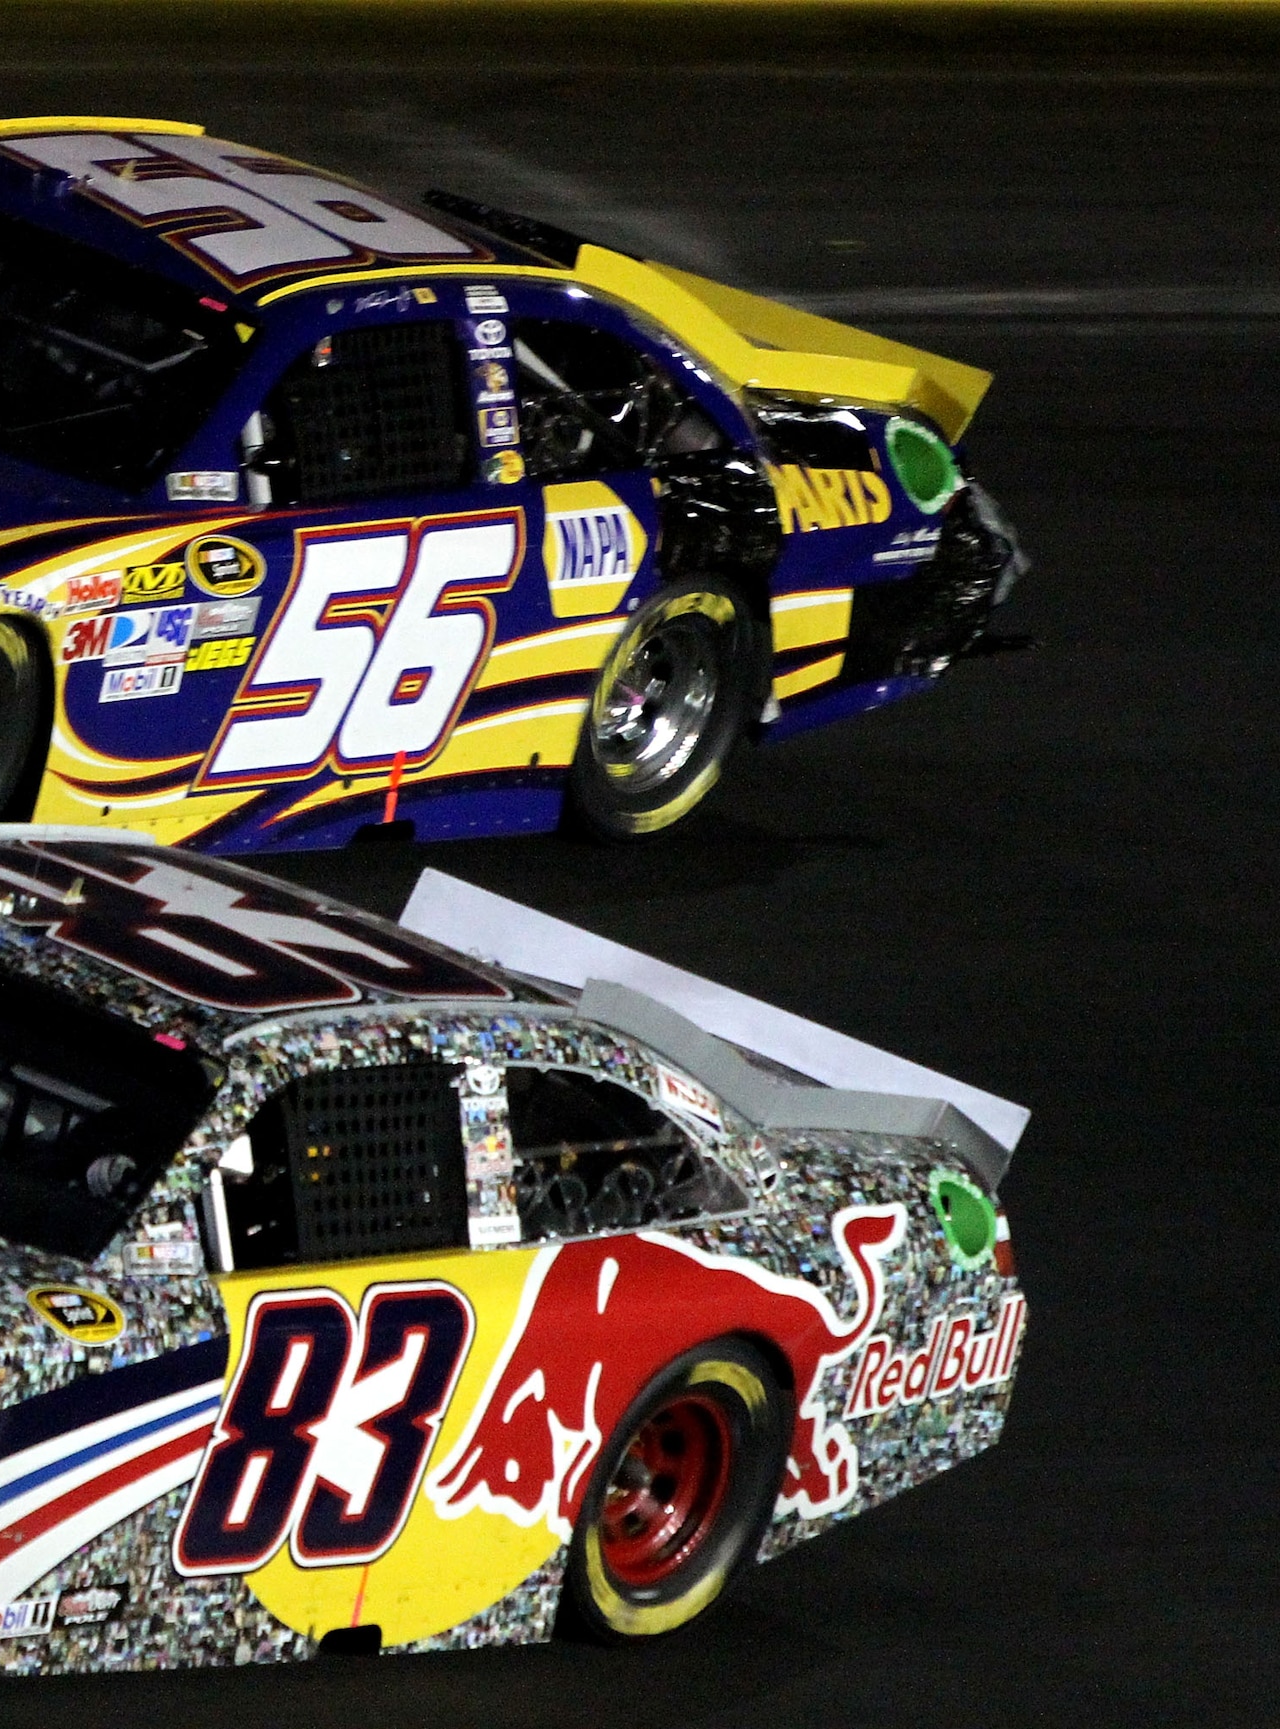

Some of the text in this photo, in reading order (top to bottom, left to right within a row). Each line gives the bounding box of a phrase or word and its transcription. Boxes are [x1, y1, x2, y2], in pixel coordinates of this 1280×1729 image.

[558, 512, 628, 581] NAPA
[62, 616, 114, 661] 3M
[184, 636, 258, 673] JEGS
[188, 505, 525, 797] 56
[108, 668, 158, 693] Mobil
[846, 1298, 1026, 1416] Red Bull
[173, 1280, 476, 1577] 83
